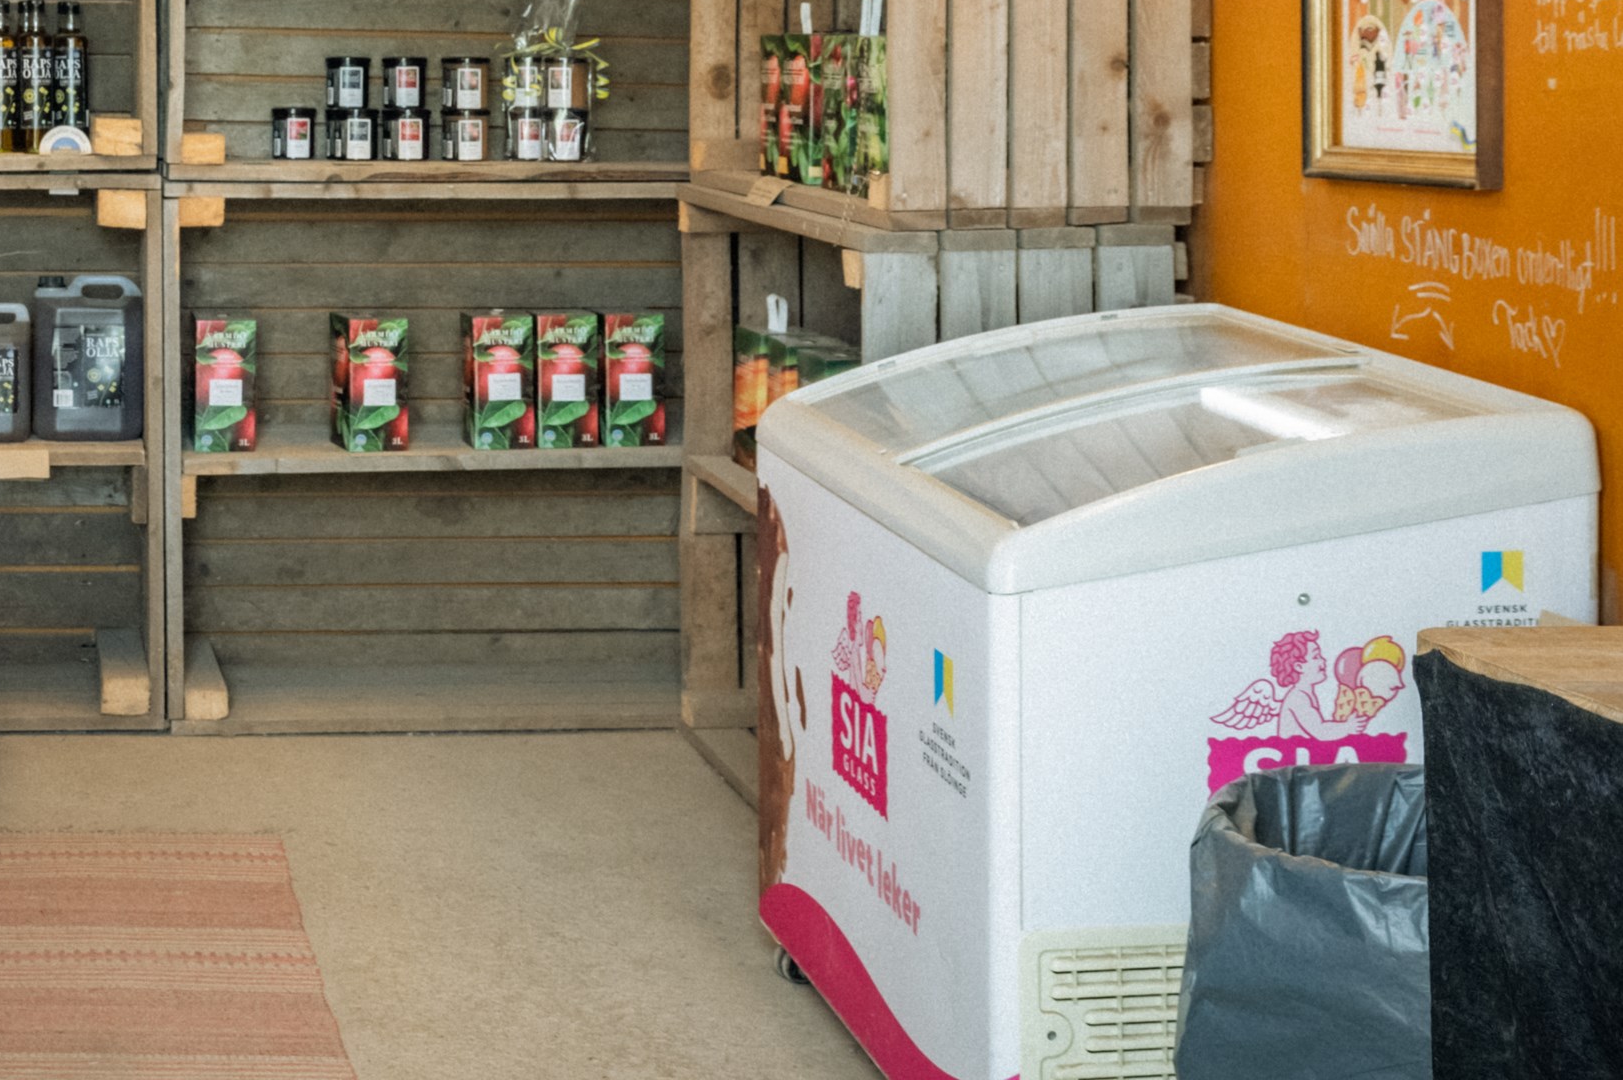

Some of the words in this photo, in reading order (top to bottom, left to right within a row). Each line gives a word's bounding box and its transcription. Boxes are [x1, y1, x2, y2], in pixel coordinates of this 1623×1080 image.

[22, 58, 52, 70] RAPS
[22, 70, 52, 80] OLJA
[1346, 203, 1396, 258] Snälla
[1400, 208, 1460, 274] STÄNG
[85, 336, 120, 347] RAPS
[1492, 299, 1548, 359] Tack
[85, 347, 120, 358] OLJA
[1478, 604, 1528, 614] SVENSK
[839, 691, 878, 776] SIA
[932, 721, 956, 750] SVENSK
[843, 757, 877, 797] GLASS
[805, 777, 834, 842] När
[835, 805, 874, 887] livet
[876, 849, 921, 937] leker
